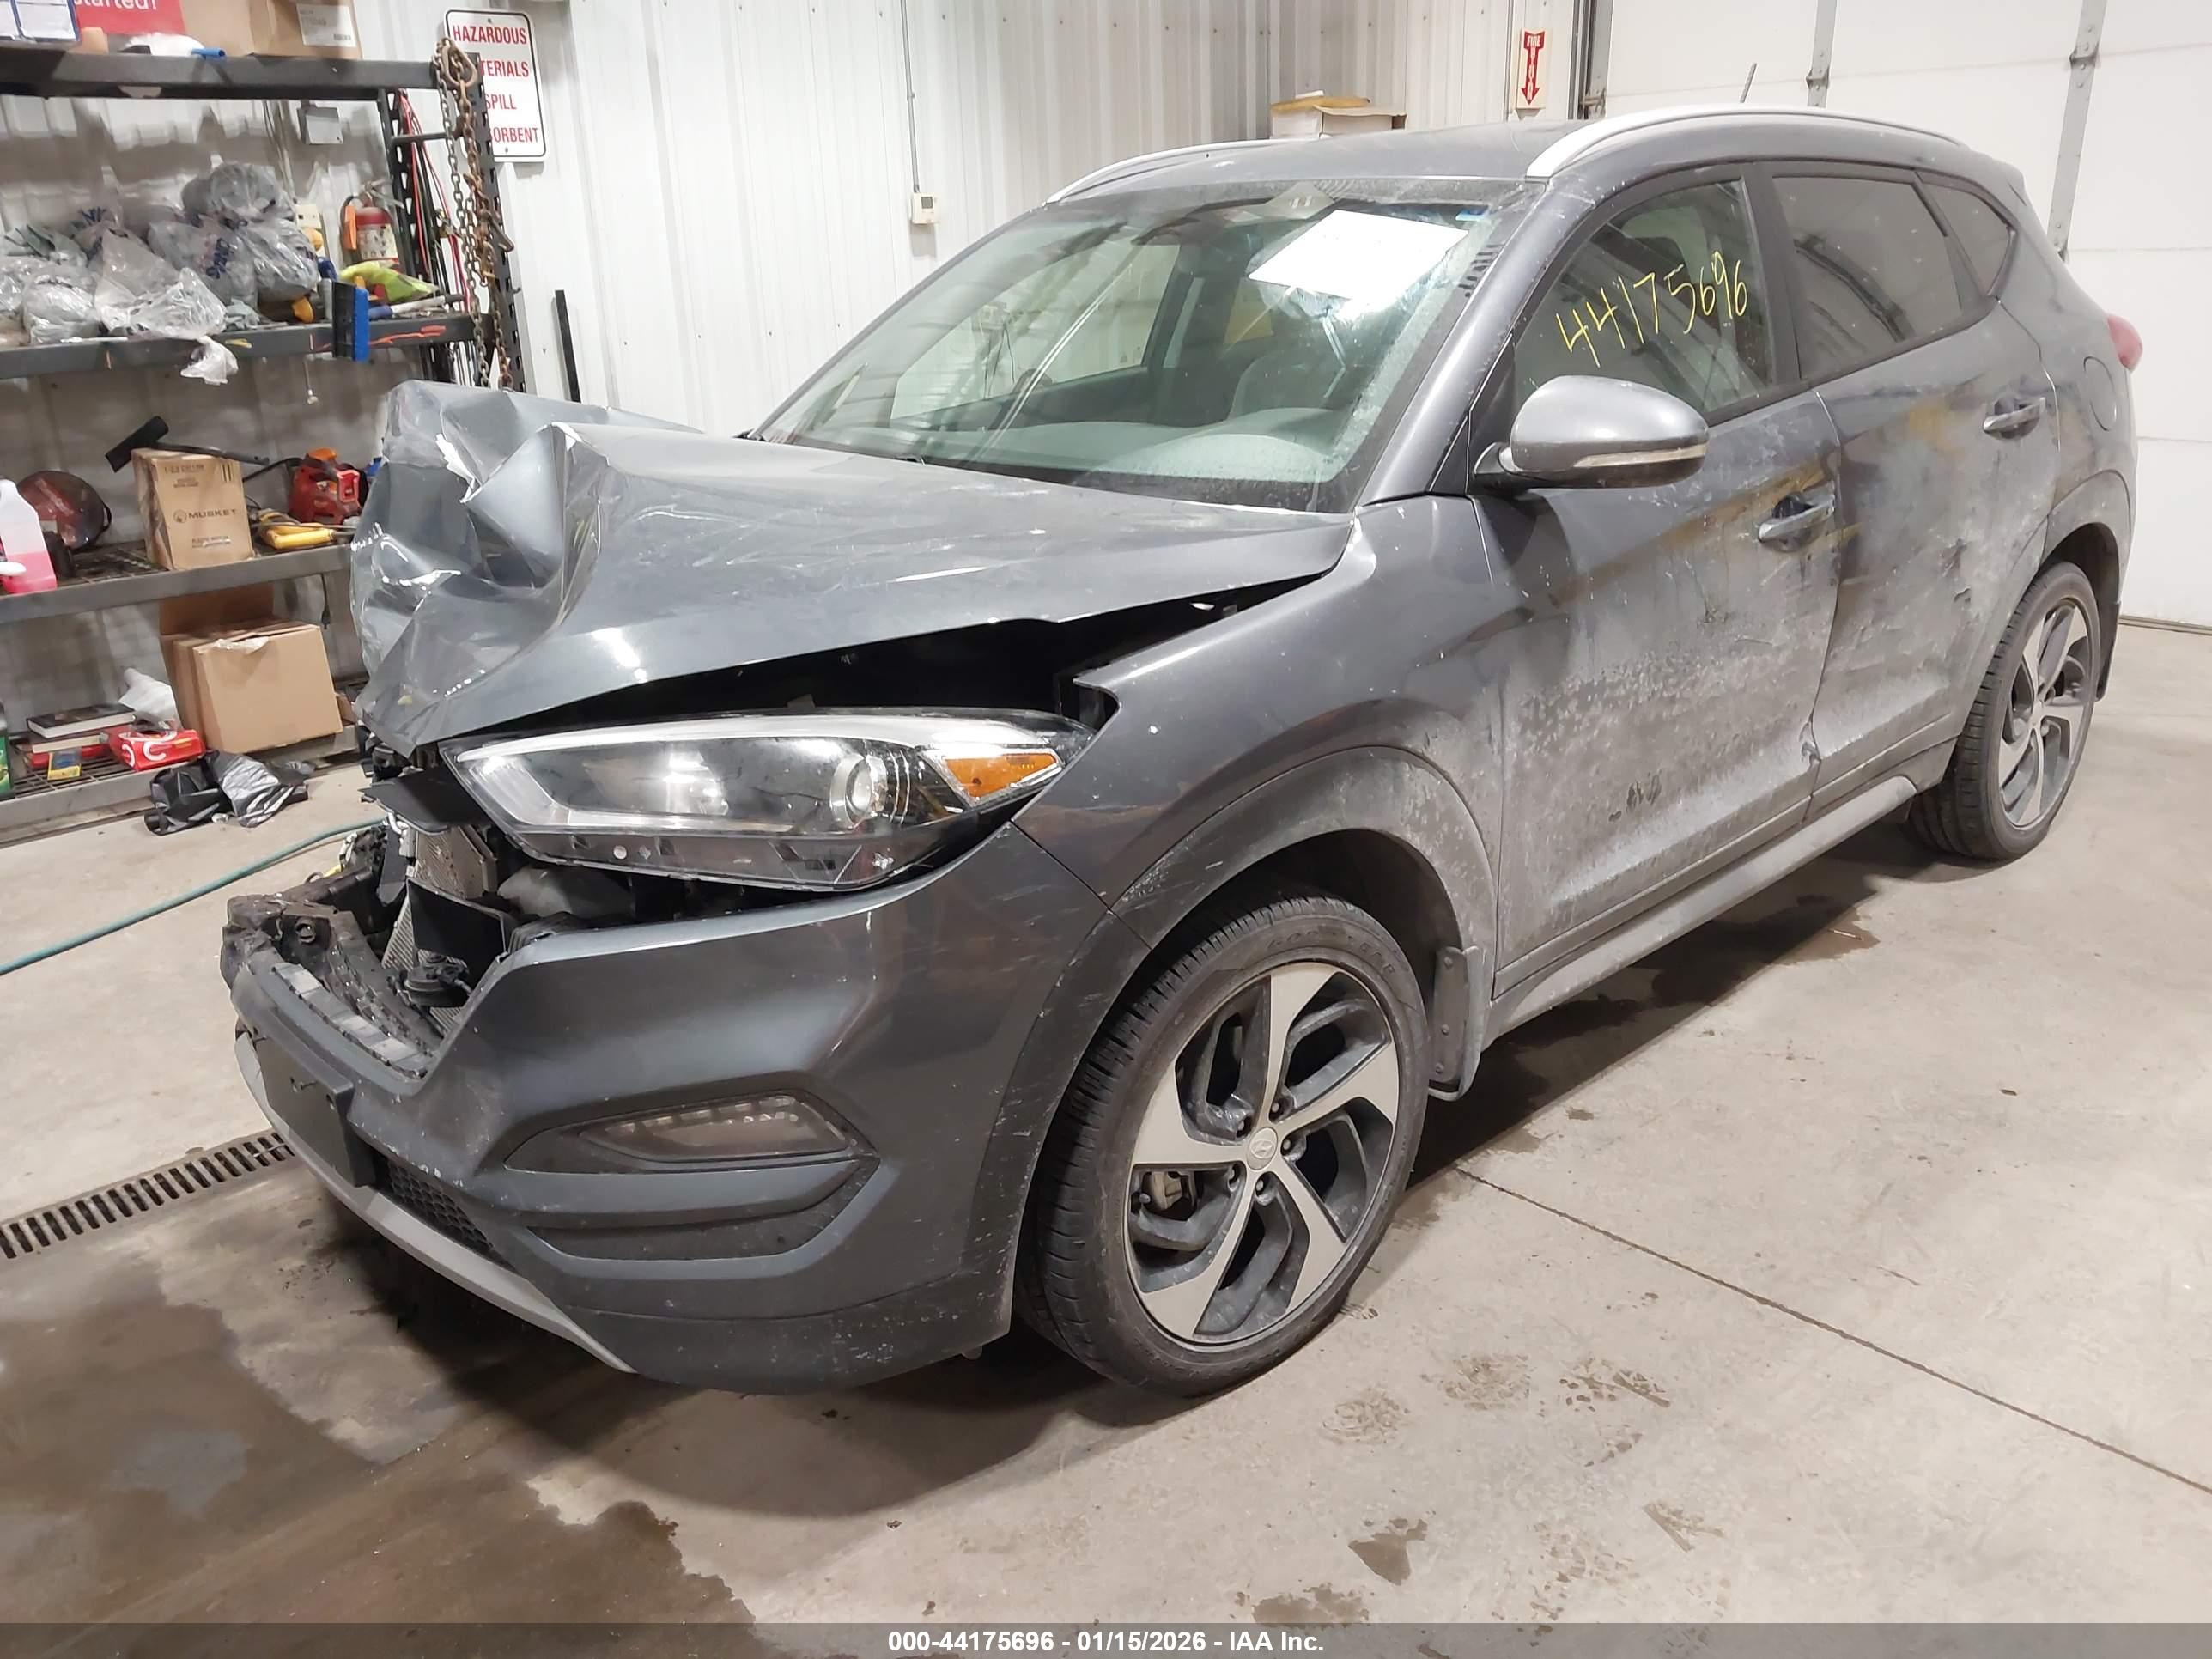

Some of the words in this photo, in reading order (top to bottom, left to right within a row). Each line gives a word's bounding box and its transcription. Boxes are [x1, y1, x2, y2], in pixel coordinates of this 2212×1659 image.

[453, 25, 527, 45] HAZARDOUS
[1526, 34, 1541, 47] FIRE
[480, 60, 530, 78] TERIALS
[485, 94, 517, 110] SPILL
[490, 127, 538, 143] ORBENT
[1556, 250, 1748, 368] 44175696
[188, 509, 237, 519] MUSKET
